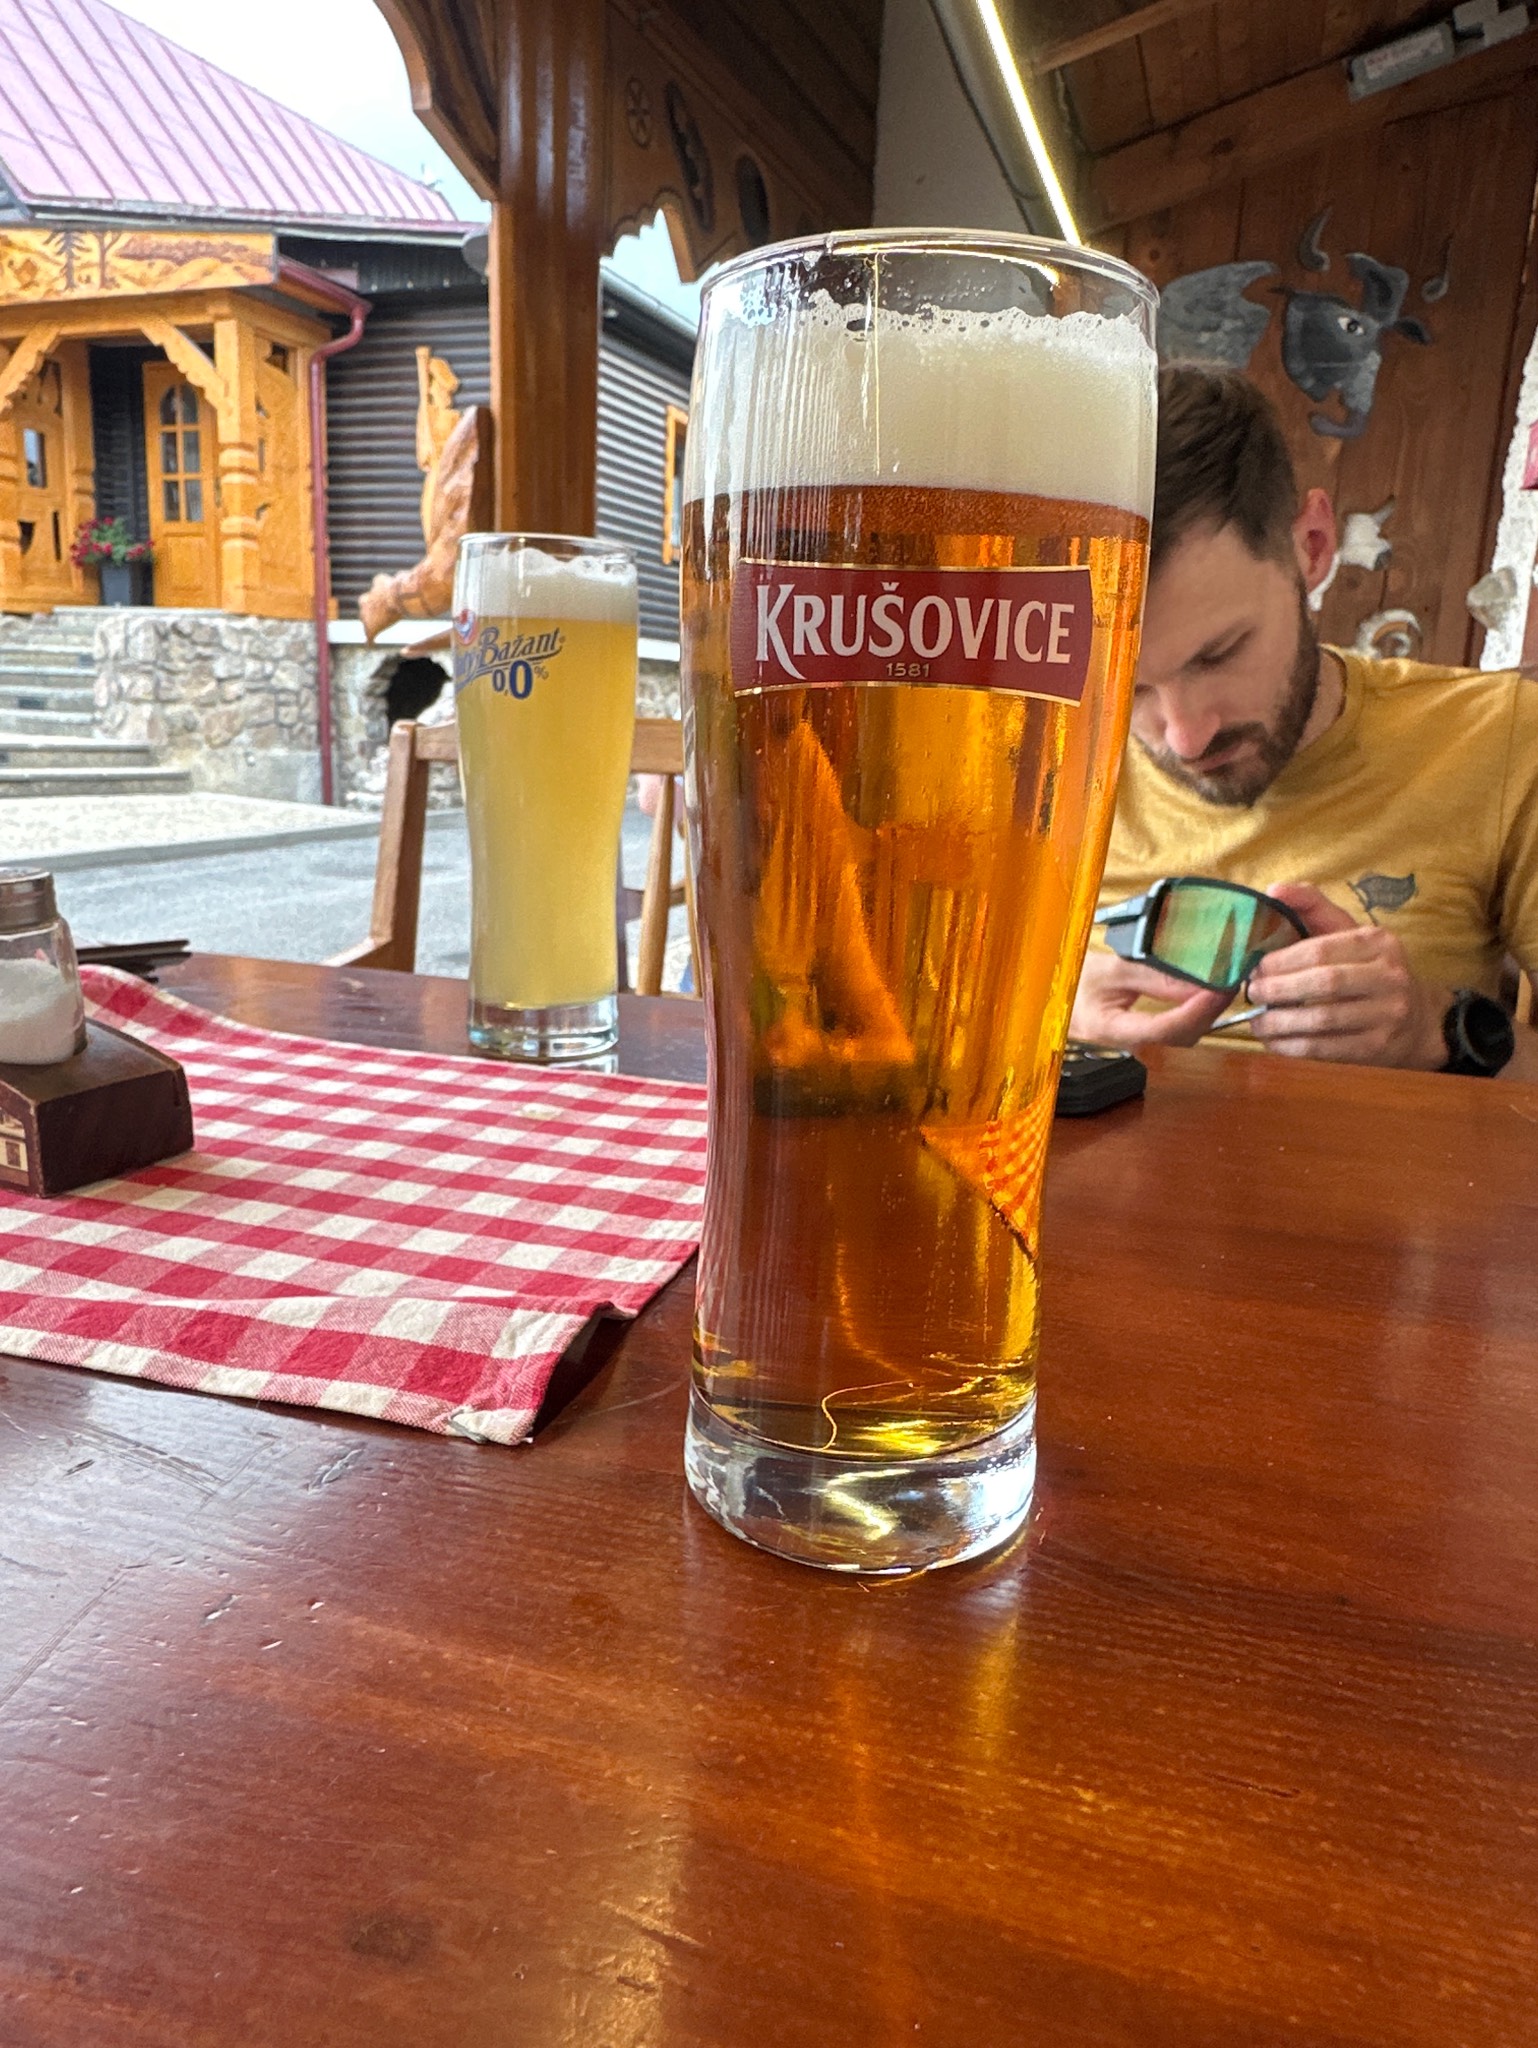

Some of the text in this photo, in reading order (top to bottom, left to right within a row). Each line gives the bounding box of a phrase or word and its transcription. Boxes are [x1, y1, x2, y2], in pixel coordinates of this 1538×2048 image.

[478, 626, 561, 667] Bažant
[755, 581, 1075, 680] KRUŠOVICE
[886, 663, 930, 678] 1581
